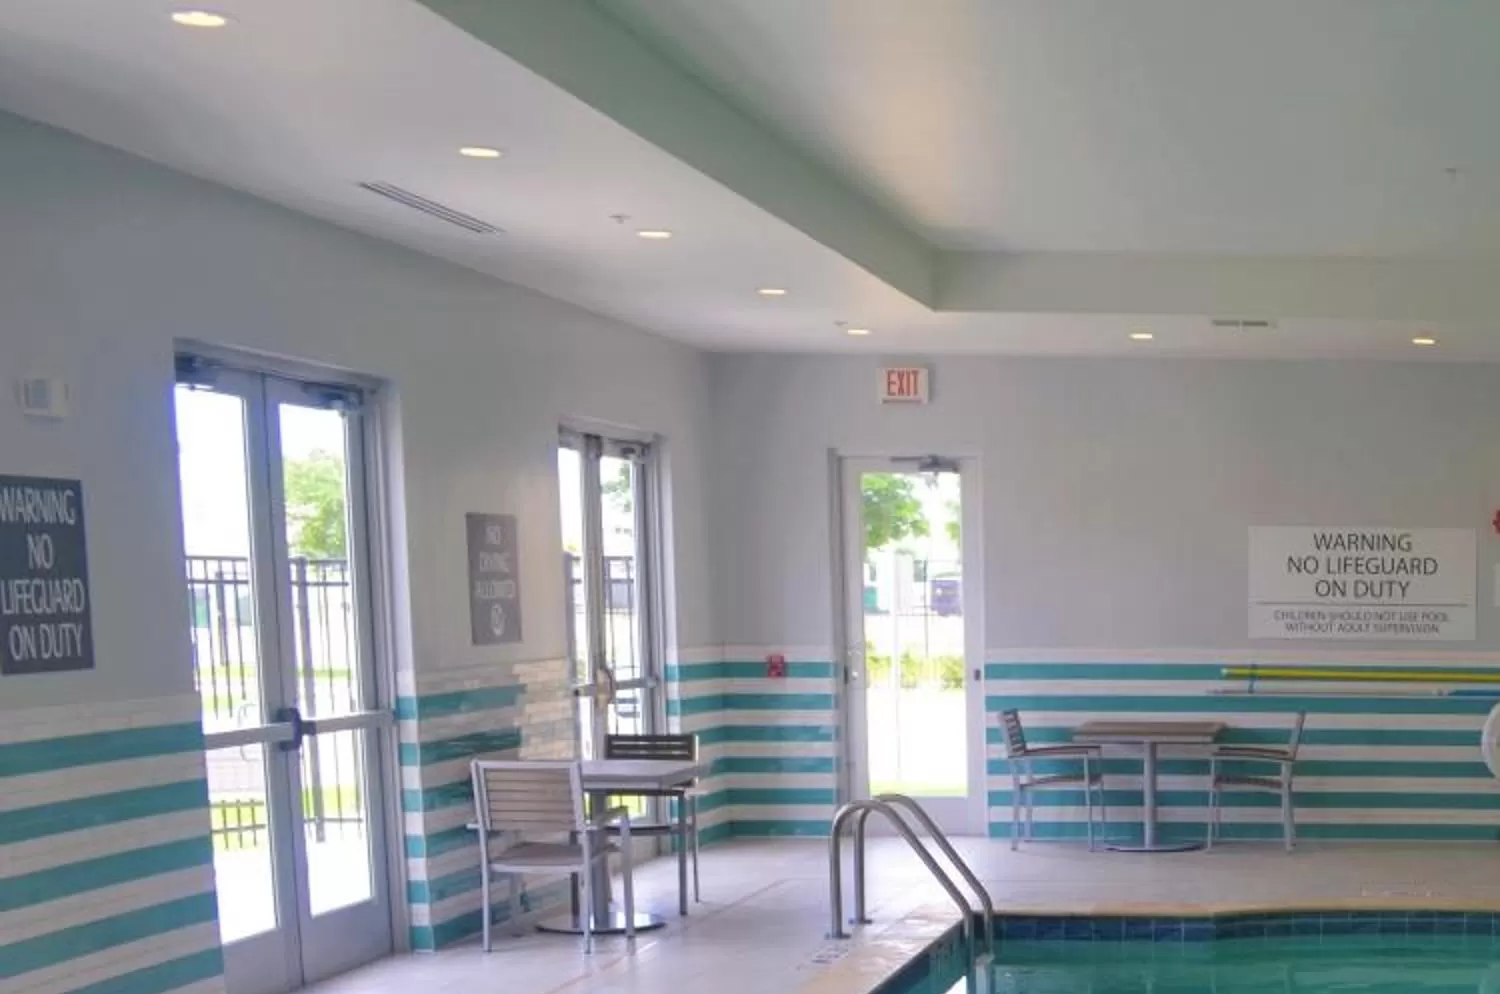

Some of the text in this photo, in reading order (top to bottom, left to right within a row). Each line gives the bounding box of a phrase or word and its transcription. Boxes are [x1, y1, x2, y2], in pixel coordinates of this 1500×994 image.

[887, 369, 919, 397] EXIT
[0, 485, 76, 525] WARNING
[27, 533, 54, 569] NO
[1313, 532, 1412, 552] WARNING
[1287, 555, 1438, 576] NO LIFEGUARD
[0, 578, 85, 615] LIFEGUARD
[1315, 579, 1410, 598] ON DUTY
[1273, 610, 1448, 622] CHILDREN SHOULD NOT USE POOL
[1285, 622, 1440, 633] WITHOUT ADULT SUPERVISION
[9, 624, 82, 661] ON DUTY
